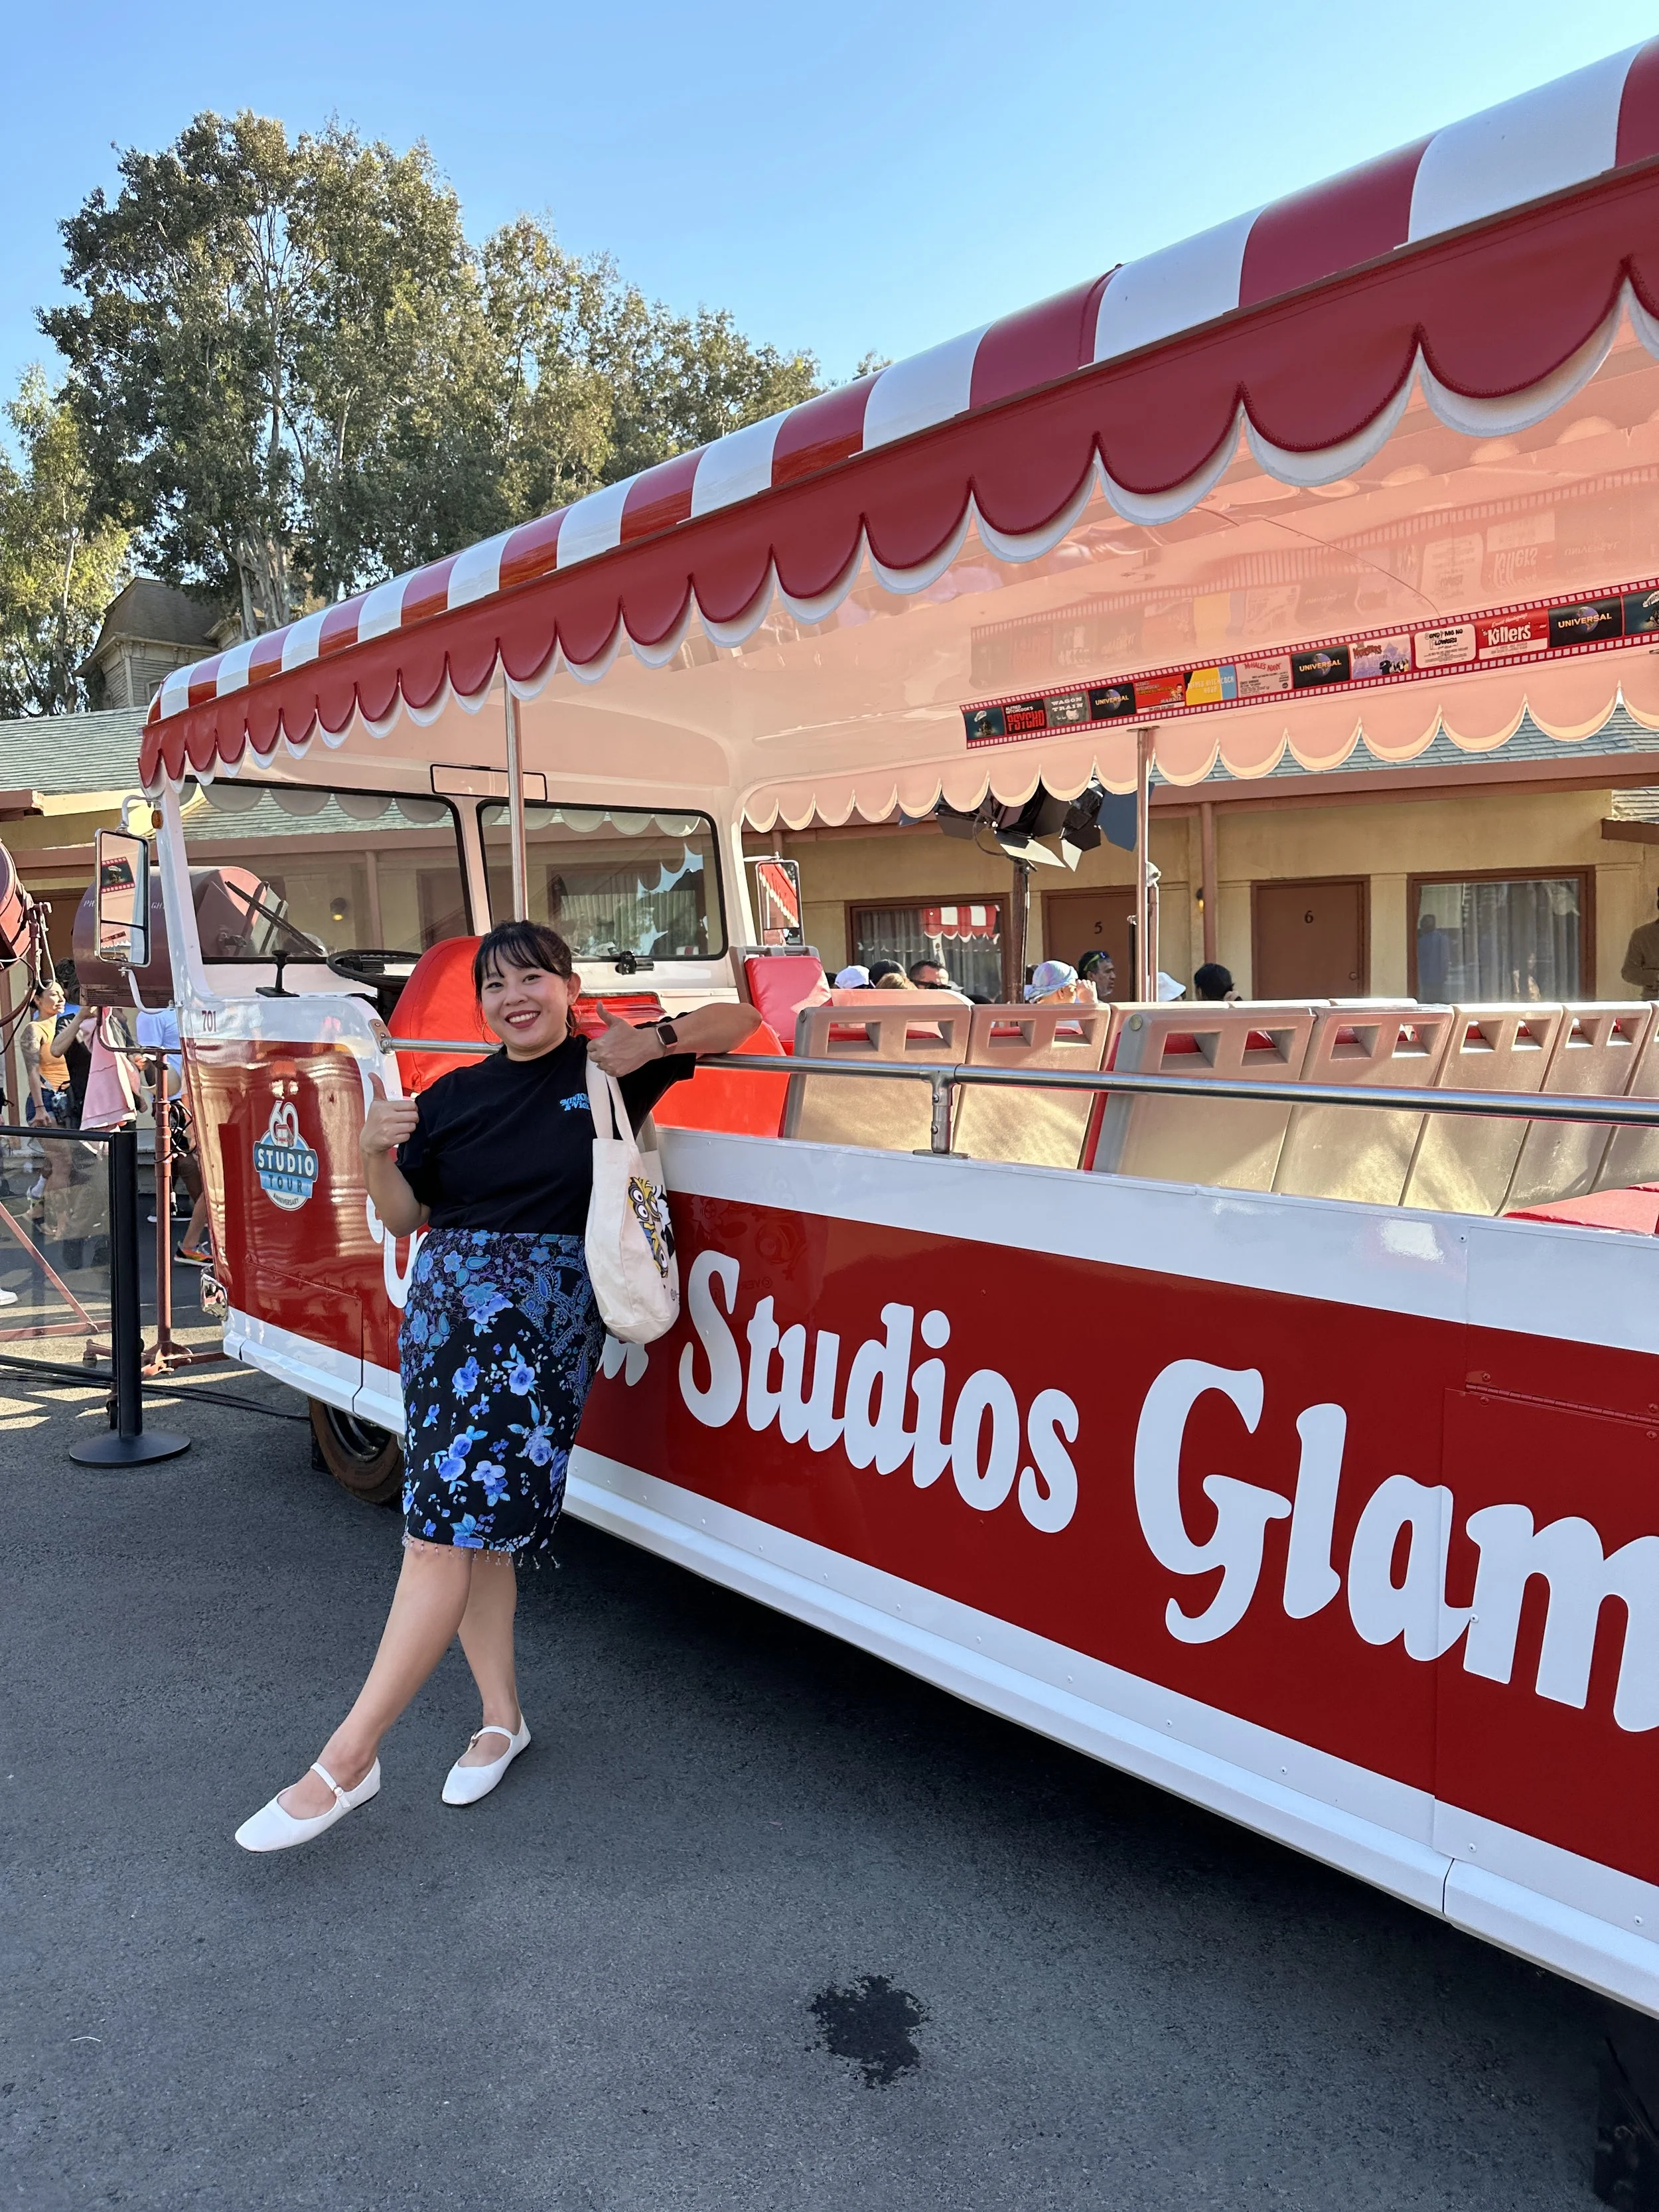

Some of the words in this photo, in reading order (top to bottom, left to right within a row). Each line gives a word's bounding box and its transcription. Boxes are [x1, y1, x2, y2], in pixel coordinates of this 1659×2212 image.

[1558, 613, 1612, 628] UNIVERSAL
[1299, 660, 1342, 672] UNIVERSAL
[1051, 697, 1082, 705] WAGON
[1095, 695, 1129, 705] UNIVERSAL
[1052, 703, 1083, 712] TRAIN
[1007, 710, 1045, 731] PSYCHO
[1305, 910, 1314, 924] 6
[1094, 921, 1103, 934] 5
[201, 1010, 216, 1032] 701
[269, 1100, 299, 1150] 60
[257, 1148, 315, 1177] STUDIO
[268, 1174, 303, 1194] TOUR
[273, 1193, 299, 1206] ANNIVERSARY
[678, 1249, 1080, 1534] Studios
[1133, 1358, 1659, 1733] Glam
